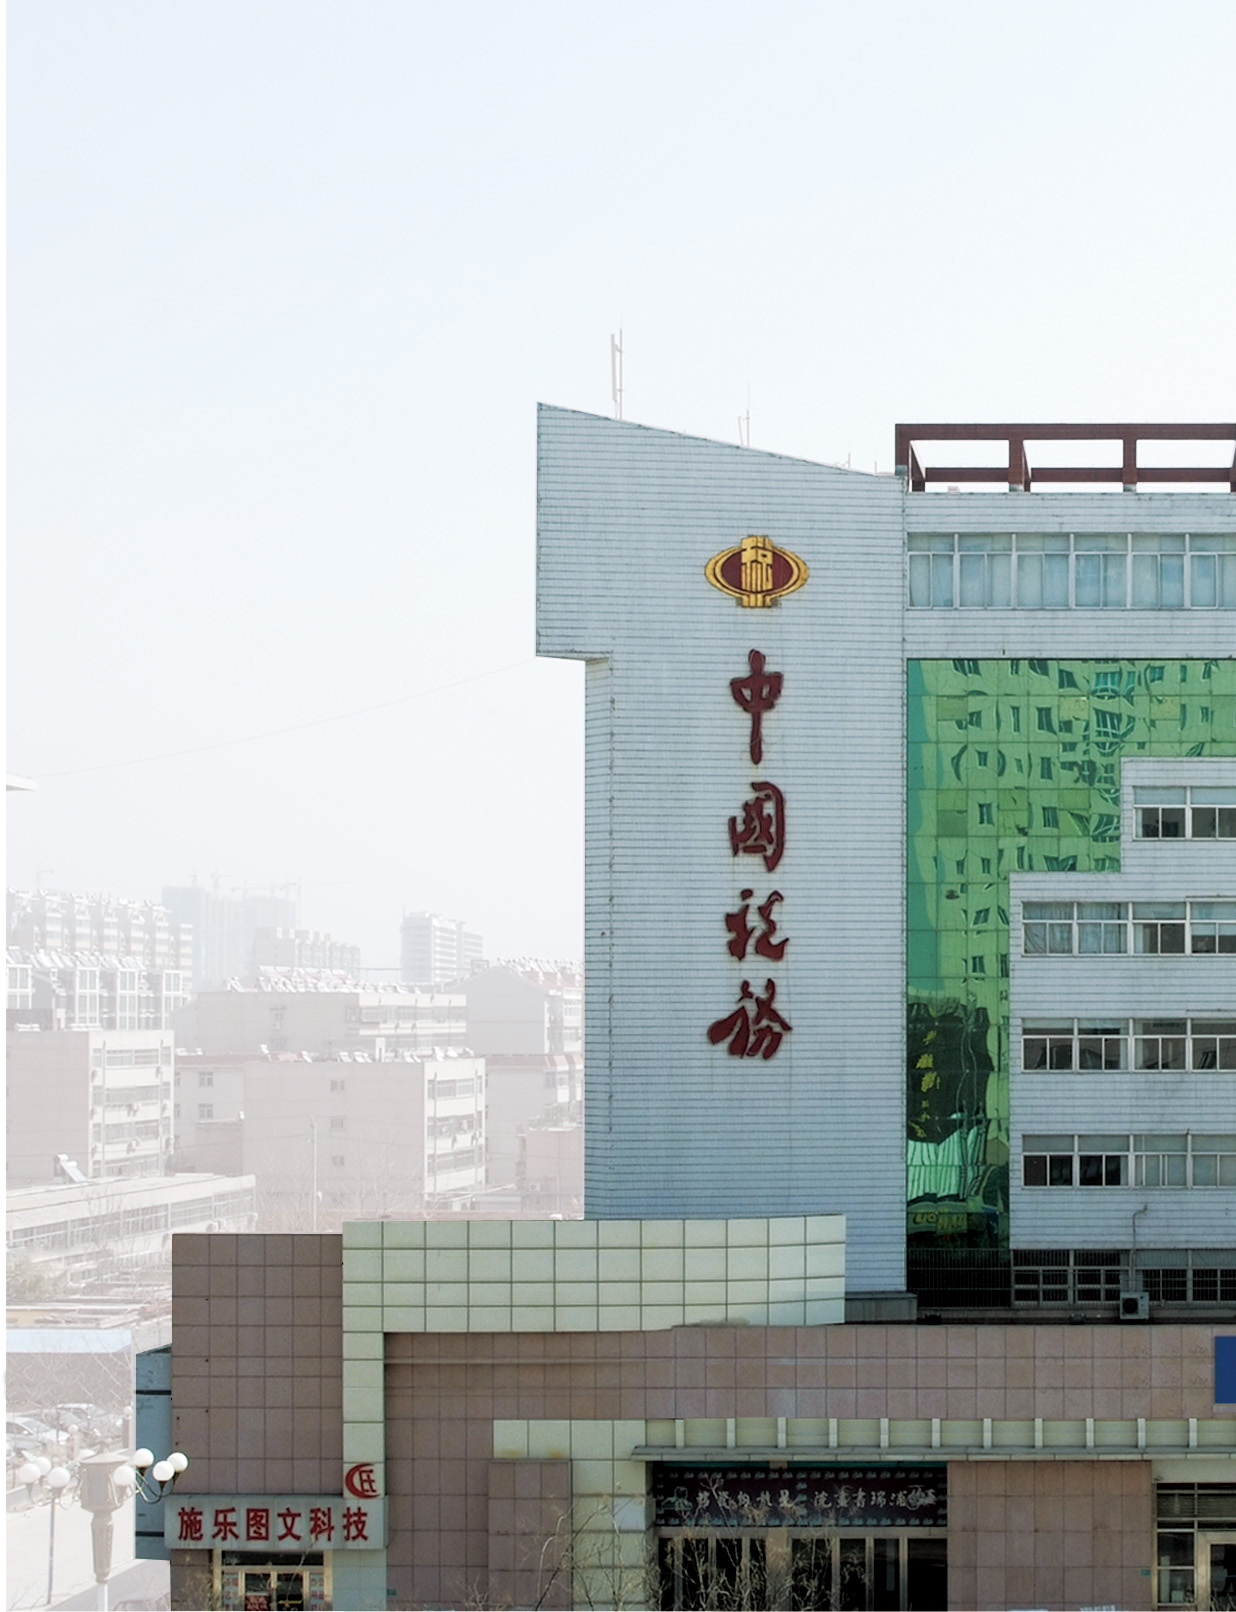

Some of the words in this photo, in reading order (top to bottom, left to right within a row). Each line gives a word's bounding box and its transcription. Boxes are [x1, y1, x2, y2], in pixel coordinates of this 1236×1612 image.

[177, 1506, 369, 1542] 施乐图文科技
